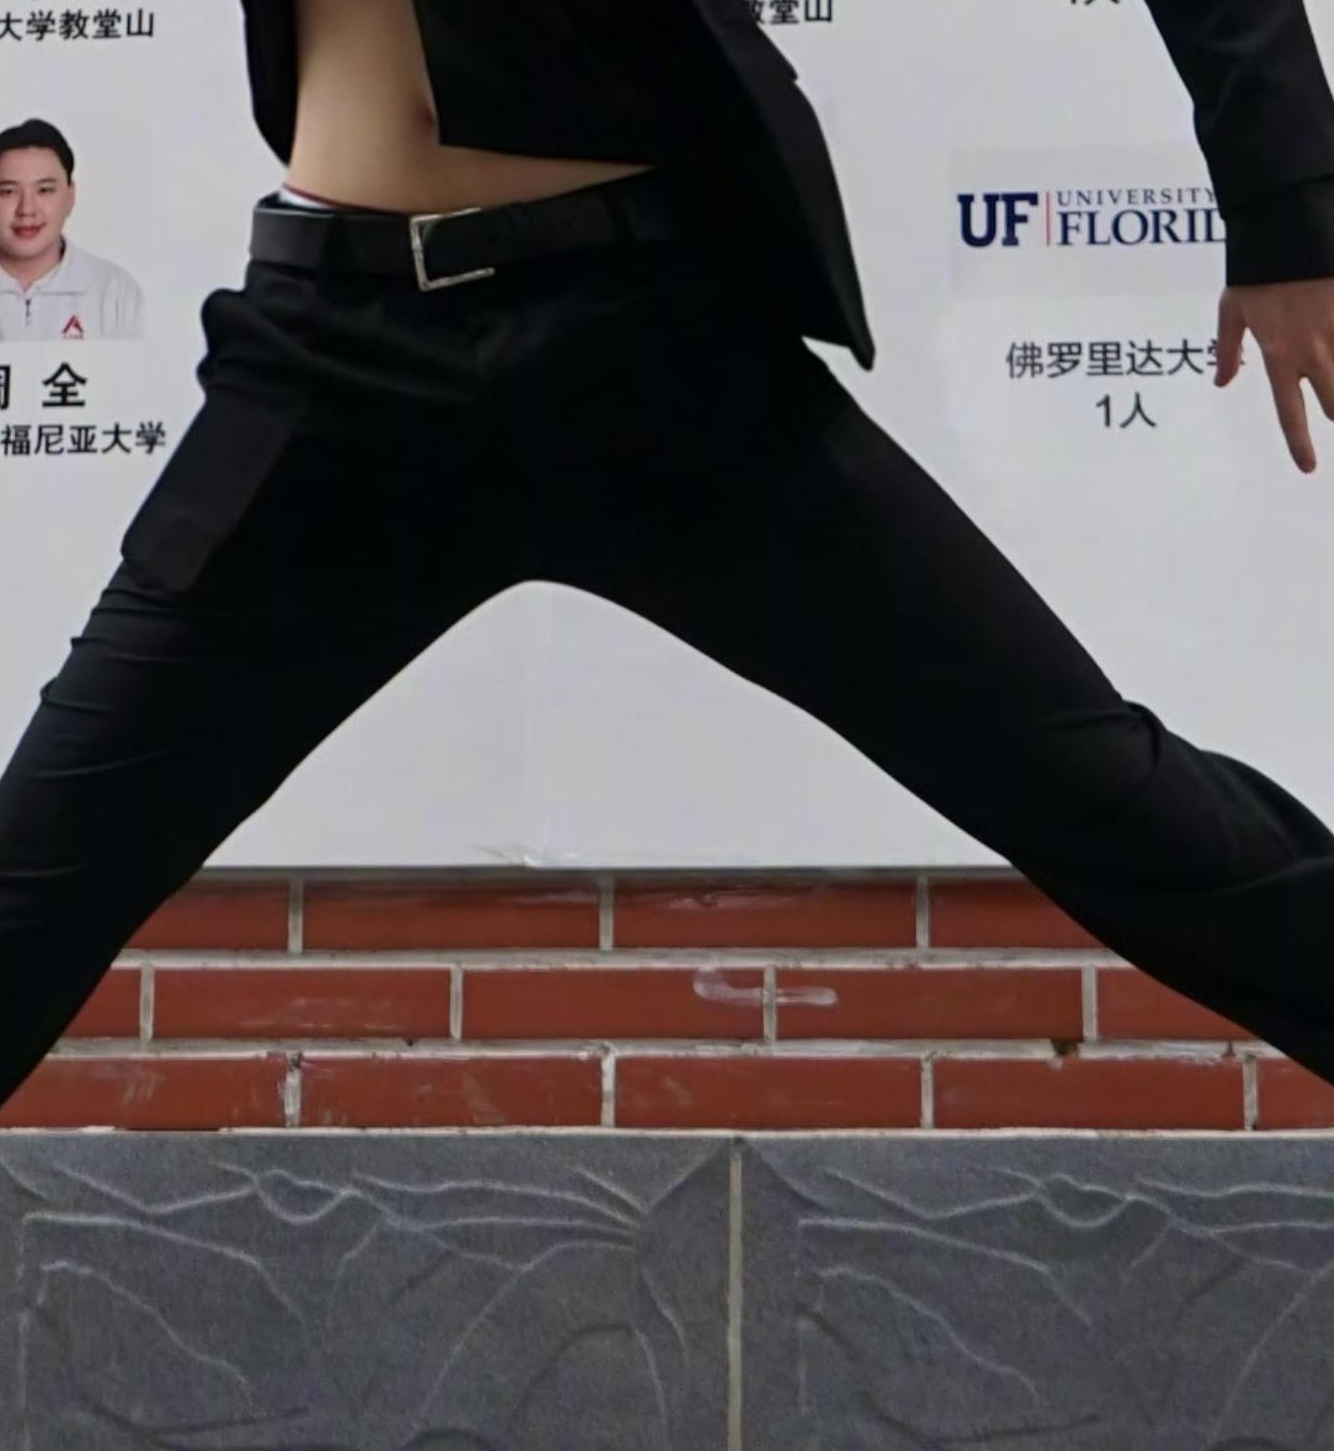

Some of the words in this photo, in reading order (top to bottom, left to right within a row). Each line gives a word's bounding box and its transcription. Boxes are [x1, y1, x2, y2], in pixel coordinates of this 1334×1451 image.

[1057, 187, 1217, 207] UNIVERSITY
[956, 191, 1039, 248] UF
[1095, 391, 1157, 429] 1人
